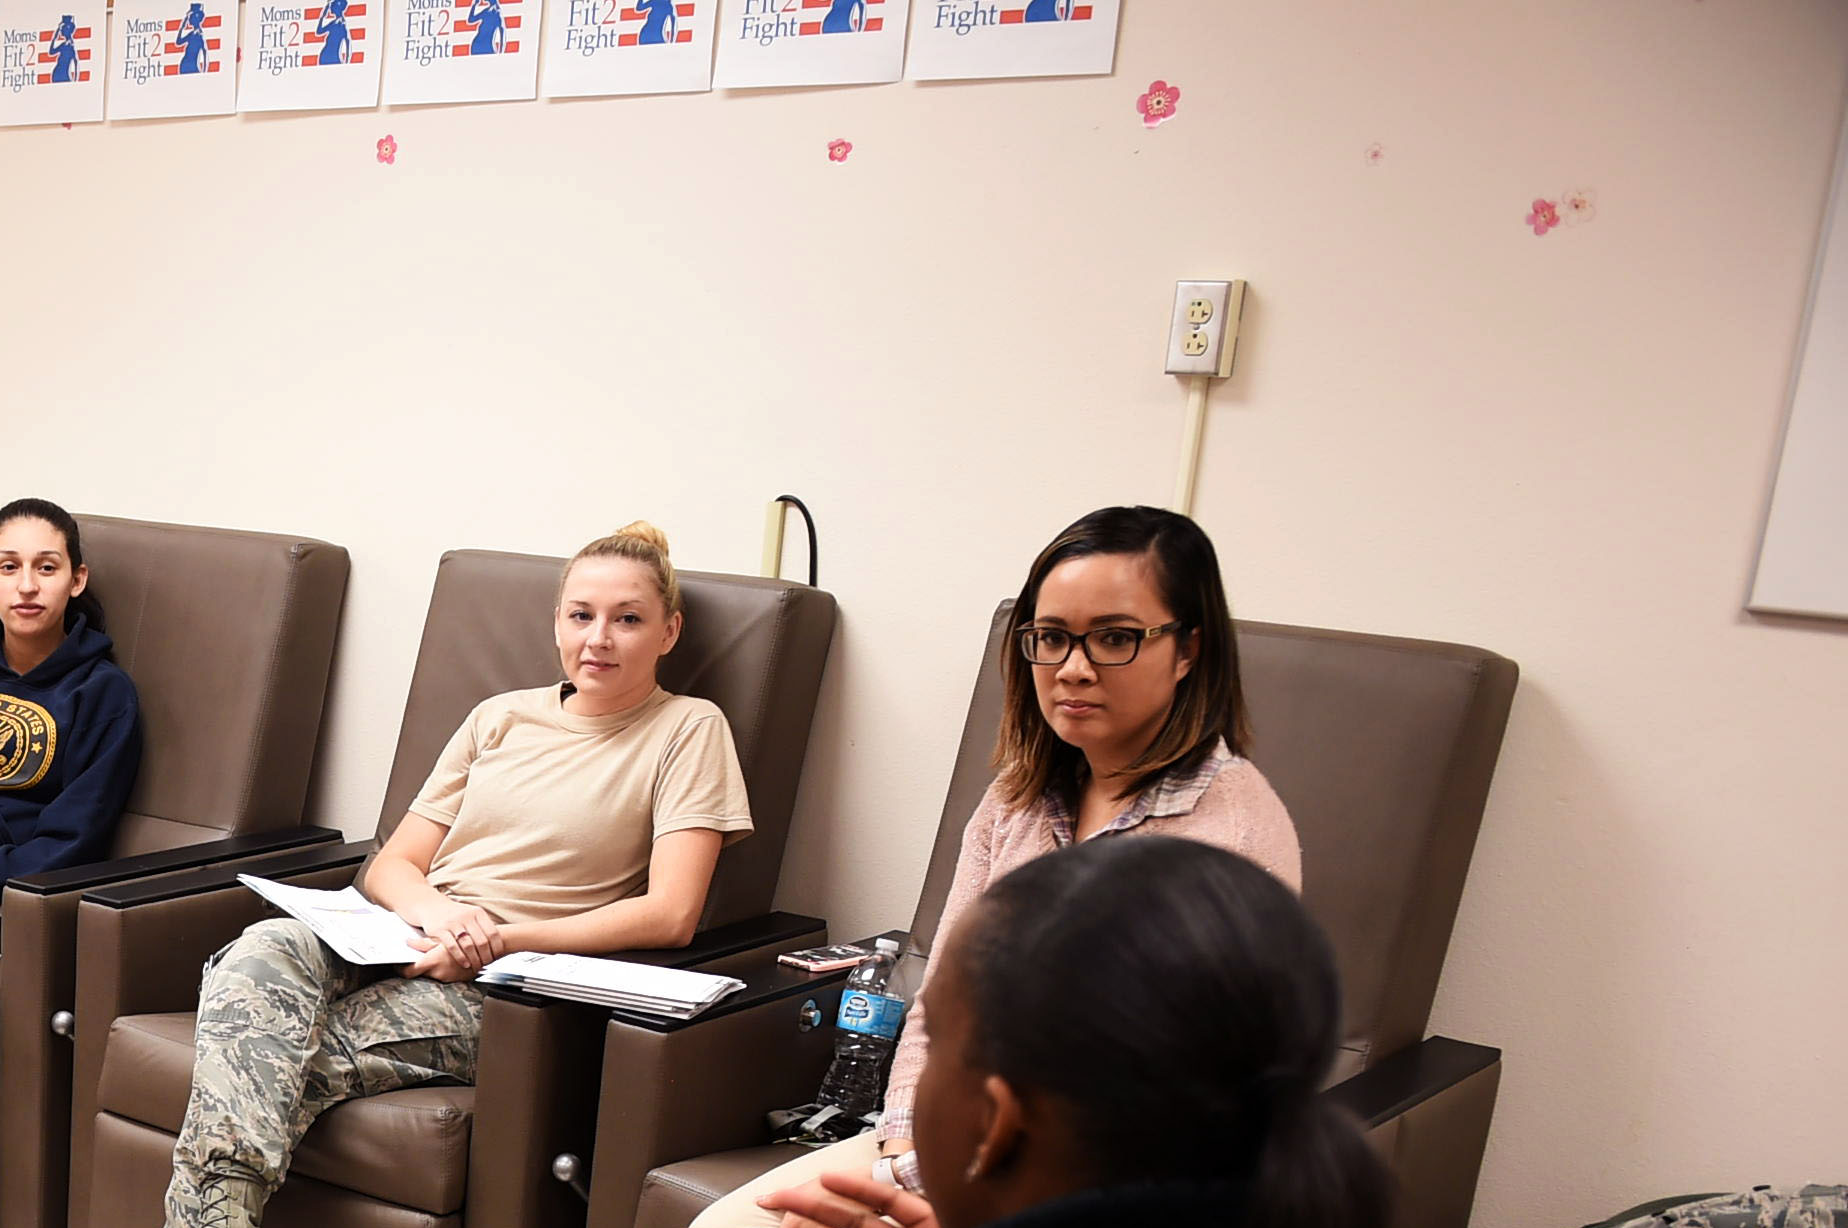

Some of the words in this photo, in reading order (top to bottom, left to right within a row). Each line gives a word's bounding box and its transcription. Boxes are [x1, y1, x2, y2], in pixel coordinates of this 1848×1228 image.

[125, 18, 163, 34] Moms
[260, 6, 302, 22] Moms
[934, 1, 998, 35] Fight
[3, 29, 38, 44] Moms
[565, 27, 617, 57] Fight
[740, 14, 798, 47] Fight
[257, 47, 301, 76] Fight
[404, 37, 451, 67] Fight
[1, 67, 36, 93] Fight
[124, 58, 163, 85] Fight
[6, 704, 45, 736] STATES
